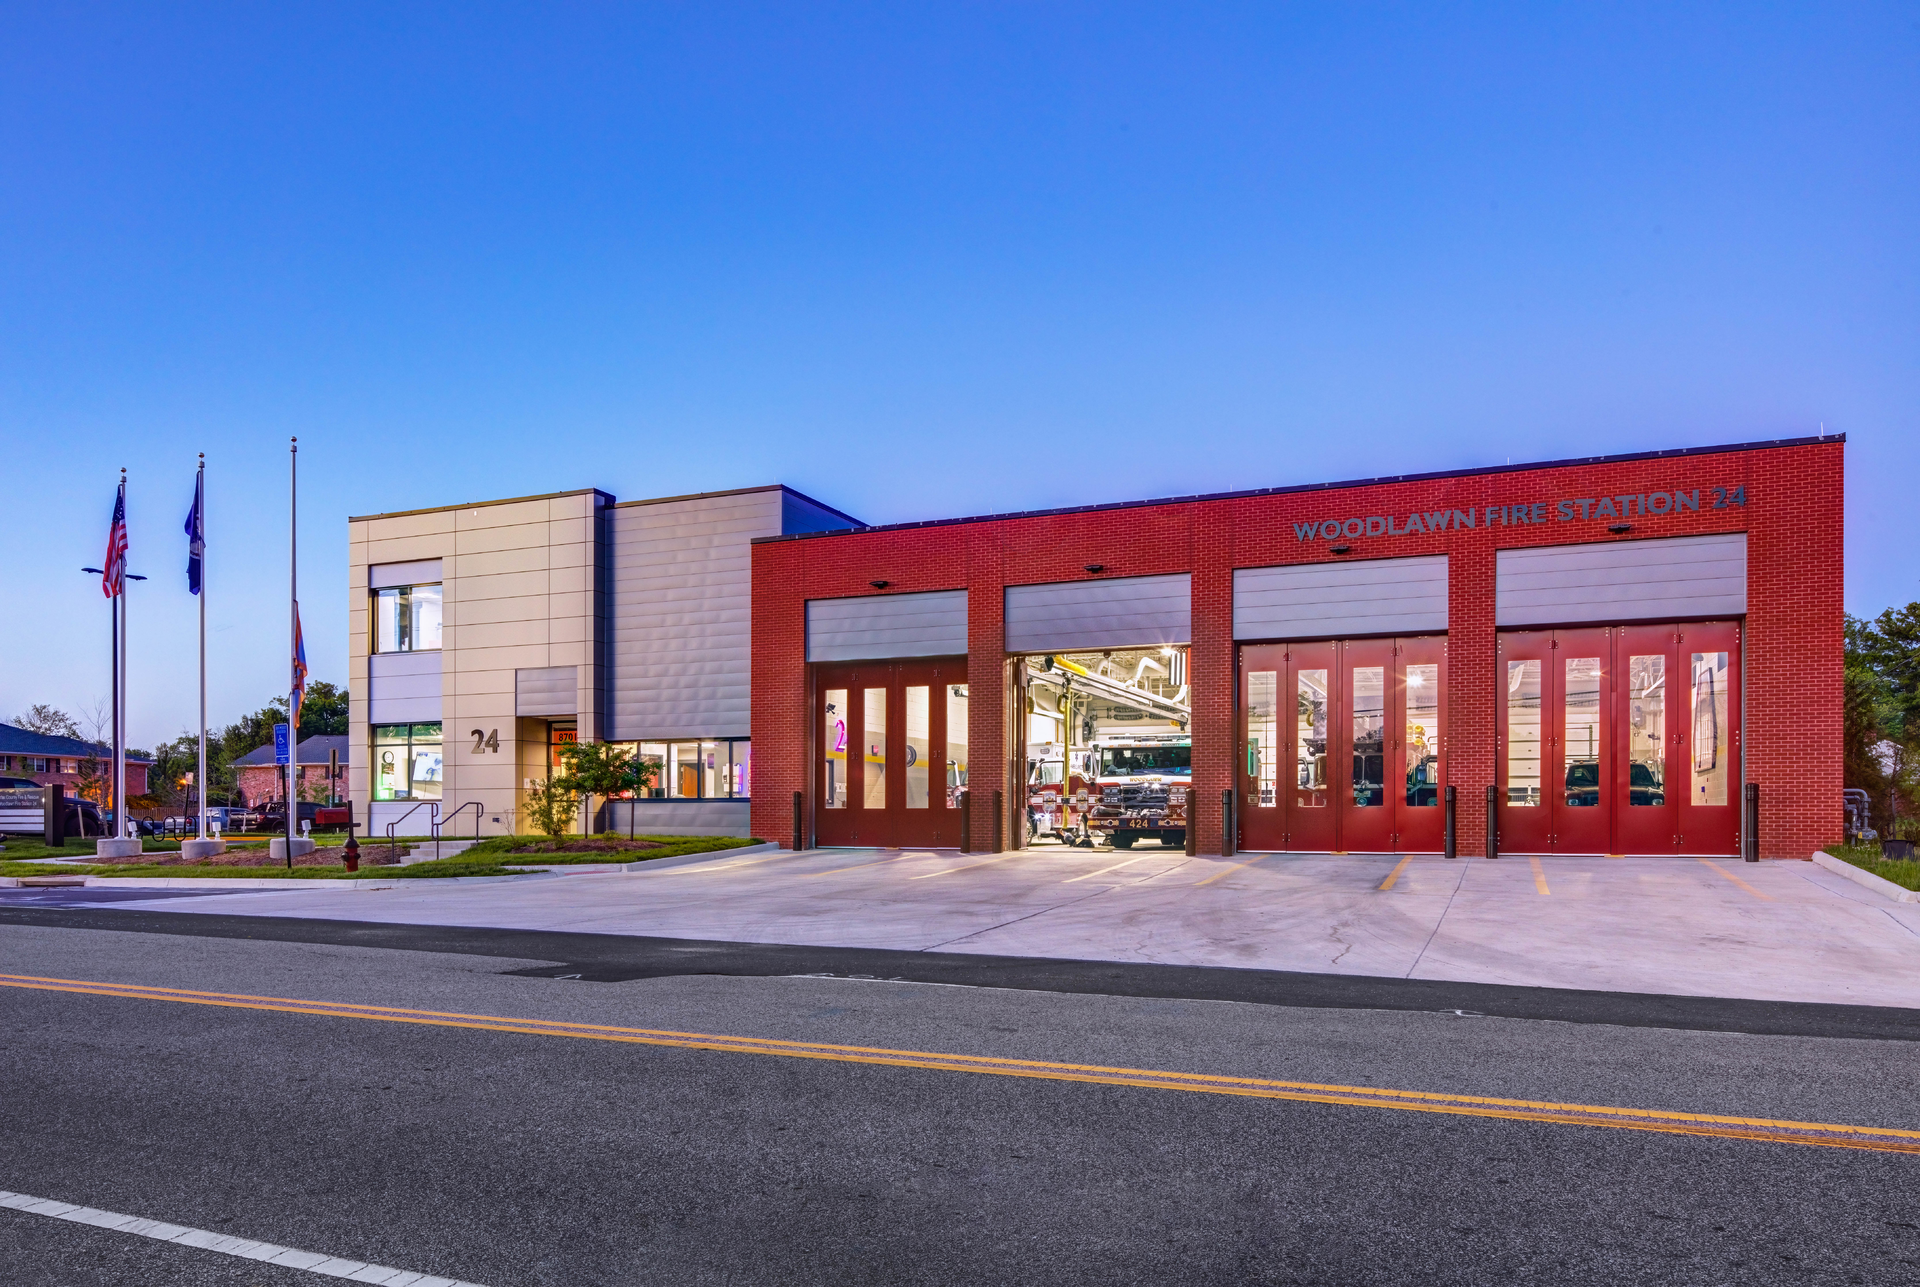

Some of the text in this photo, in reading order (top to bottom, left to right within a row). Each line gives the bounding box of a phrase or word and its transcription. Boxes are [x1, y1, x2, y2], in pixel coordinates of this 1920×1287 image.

[1293, 484, 1747, 542] WOODLAWN FIRE STATION 24
[470, 728, 500, 754] 24
[1129, 819, 1148, 828] 424
